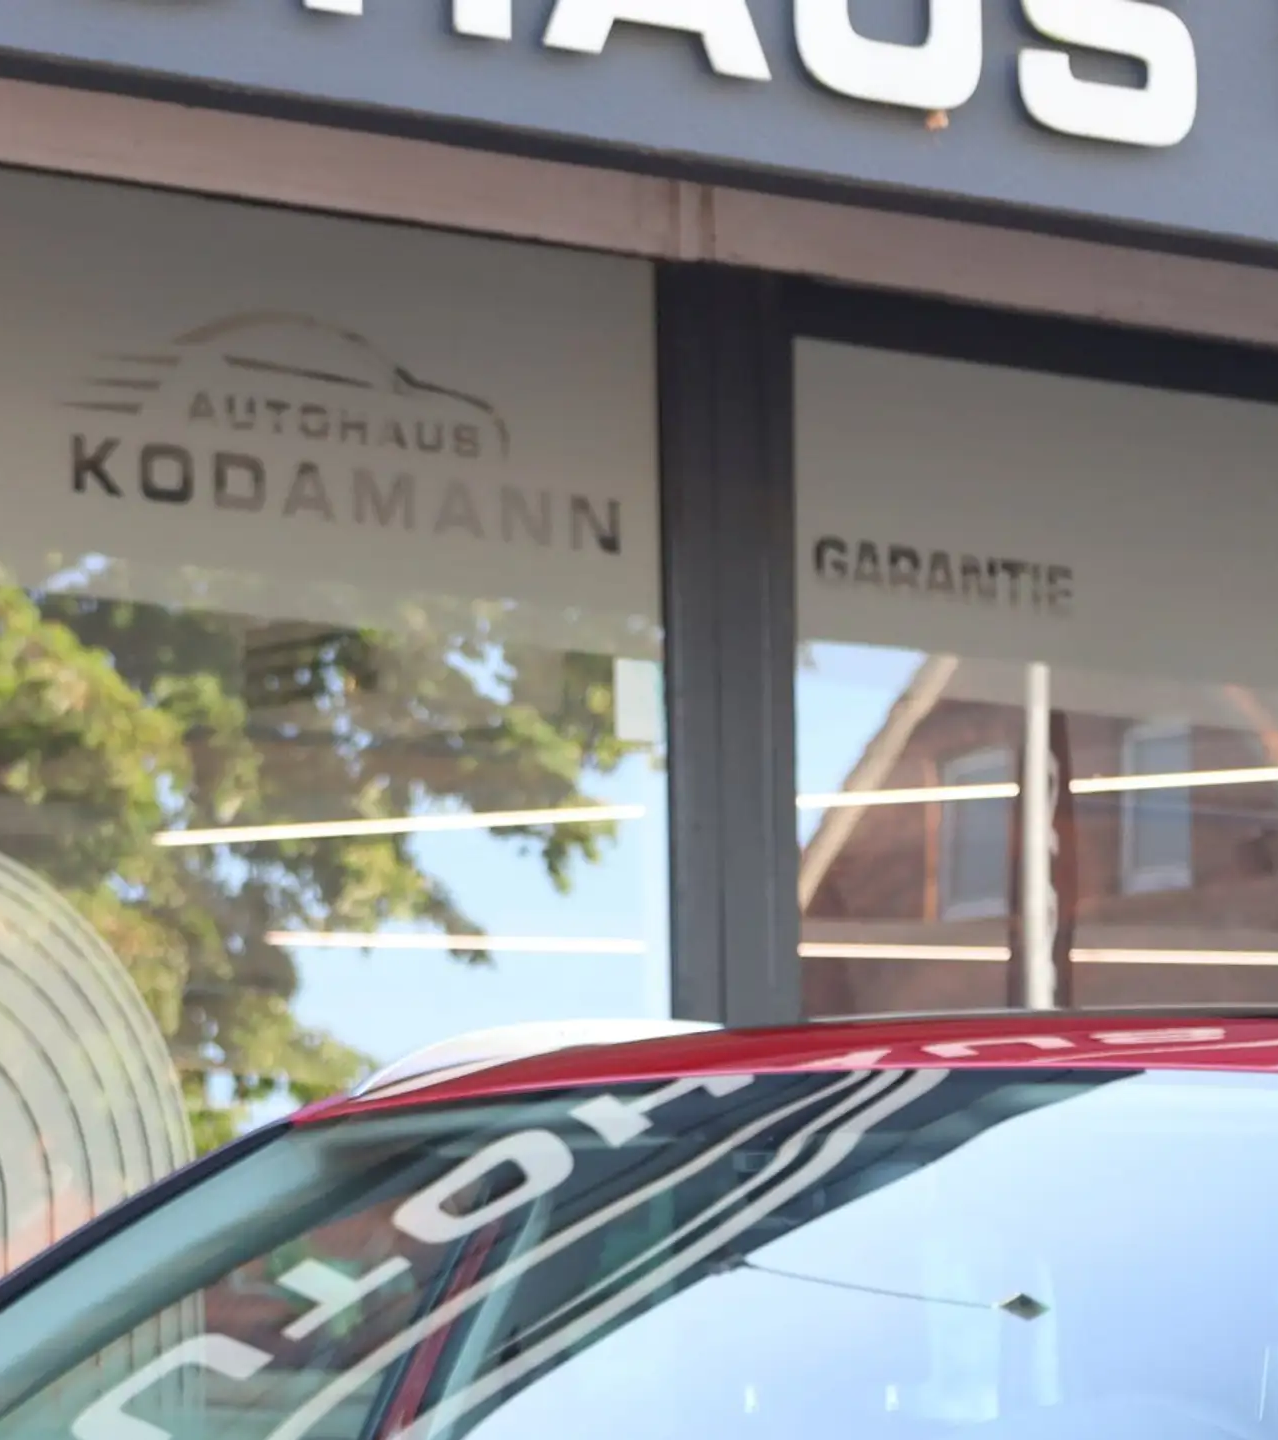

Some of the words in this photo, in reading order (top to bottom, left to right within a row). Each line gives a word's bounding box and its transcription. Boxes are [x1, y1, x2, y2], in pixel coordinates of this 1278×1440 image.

[187, 391, 483, 458] AUTOHAUS
[69, 433, 622, 554] KODAMANN
[812, 534, 1074, 617] GARANTIE
